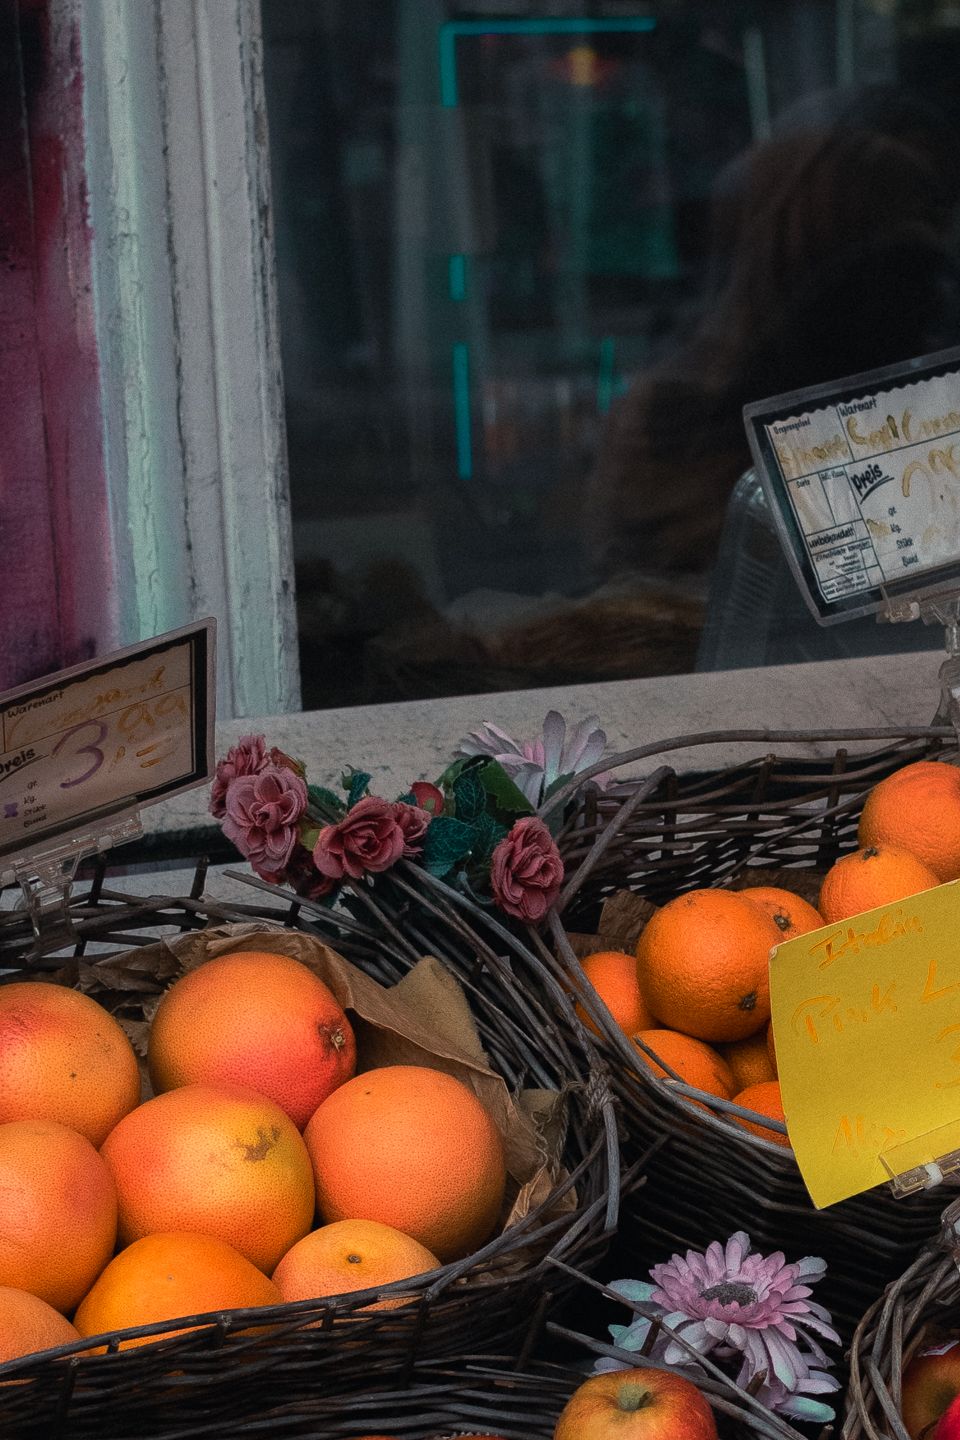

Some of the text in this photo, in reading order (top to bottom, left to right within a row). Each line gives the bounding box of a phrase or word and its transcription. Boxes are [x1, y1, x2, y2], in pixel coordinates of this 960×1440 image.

[839, 397, 877, 417] Warenart
[851, 463, 883, 497] Preis
[7, 691, 65, 719] Warenart
[51, 694, 188, 789] 3,99
[790, 981, 899, 1043] Pink
